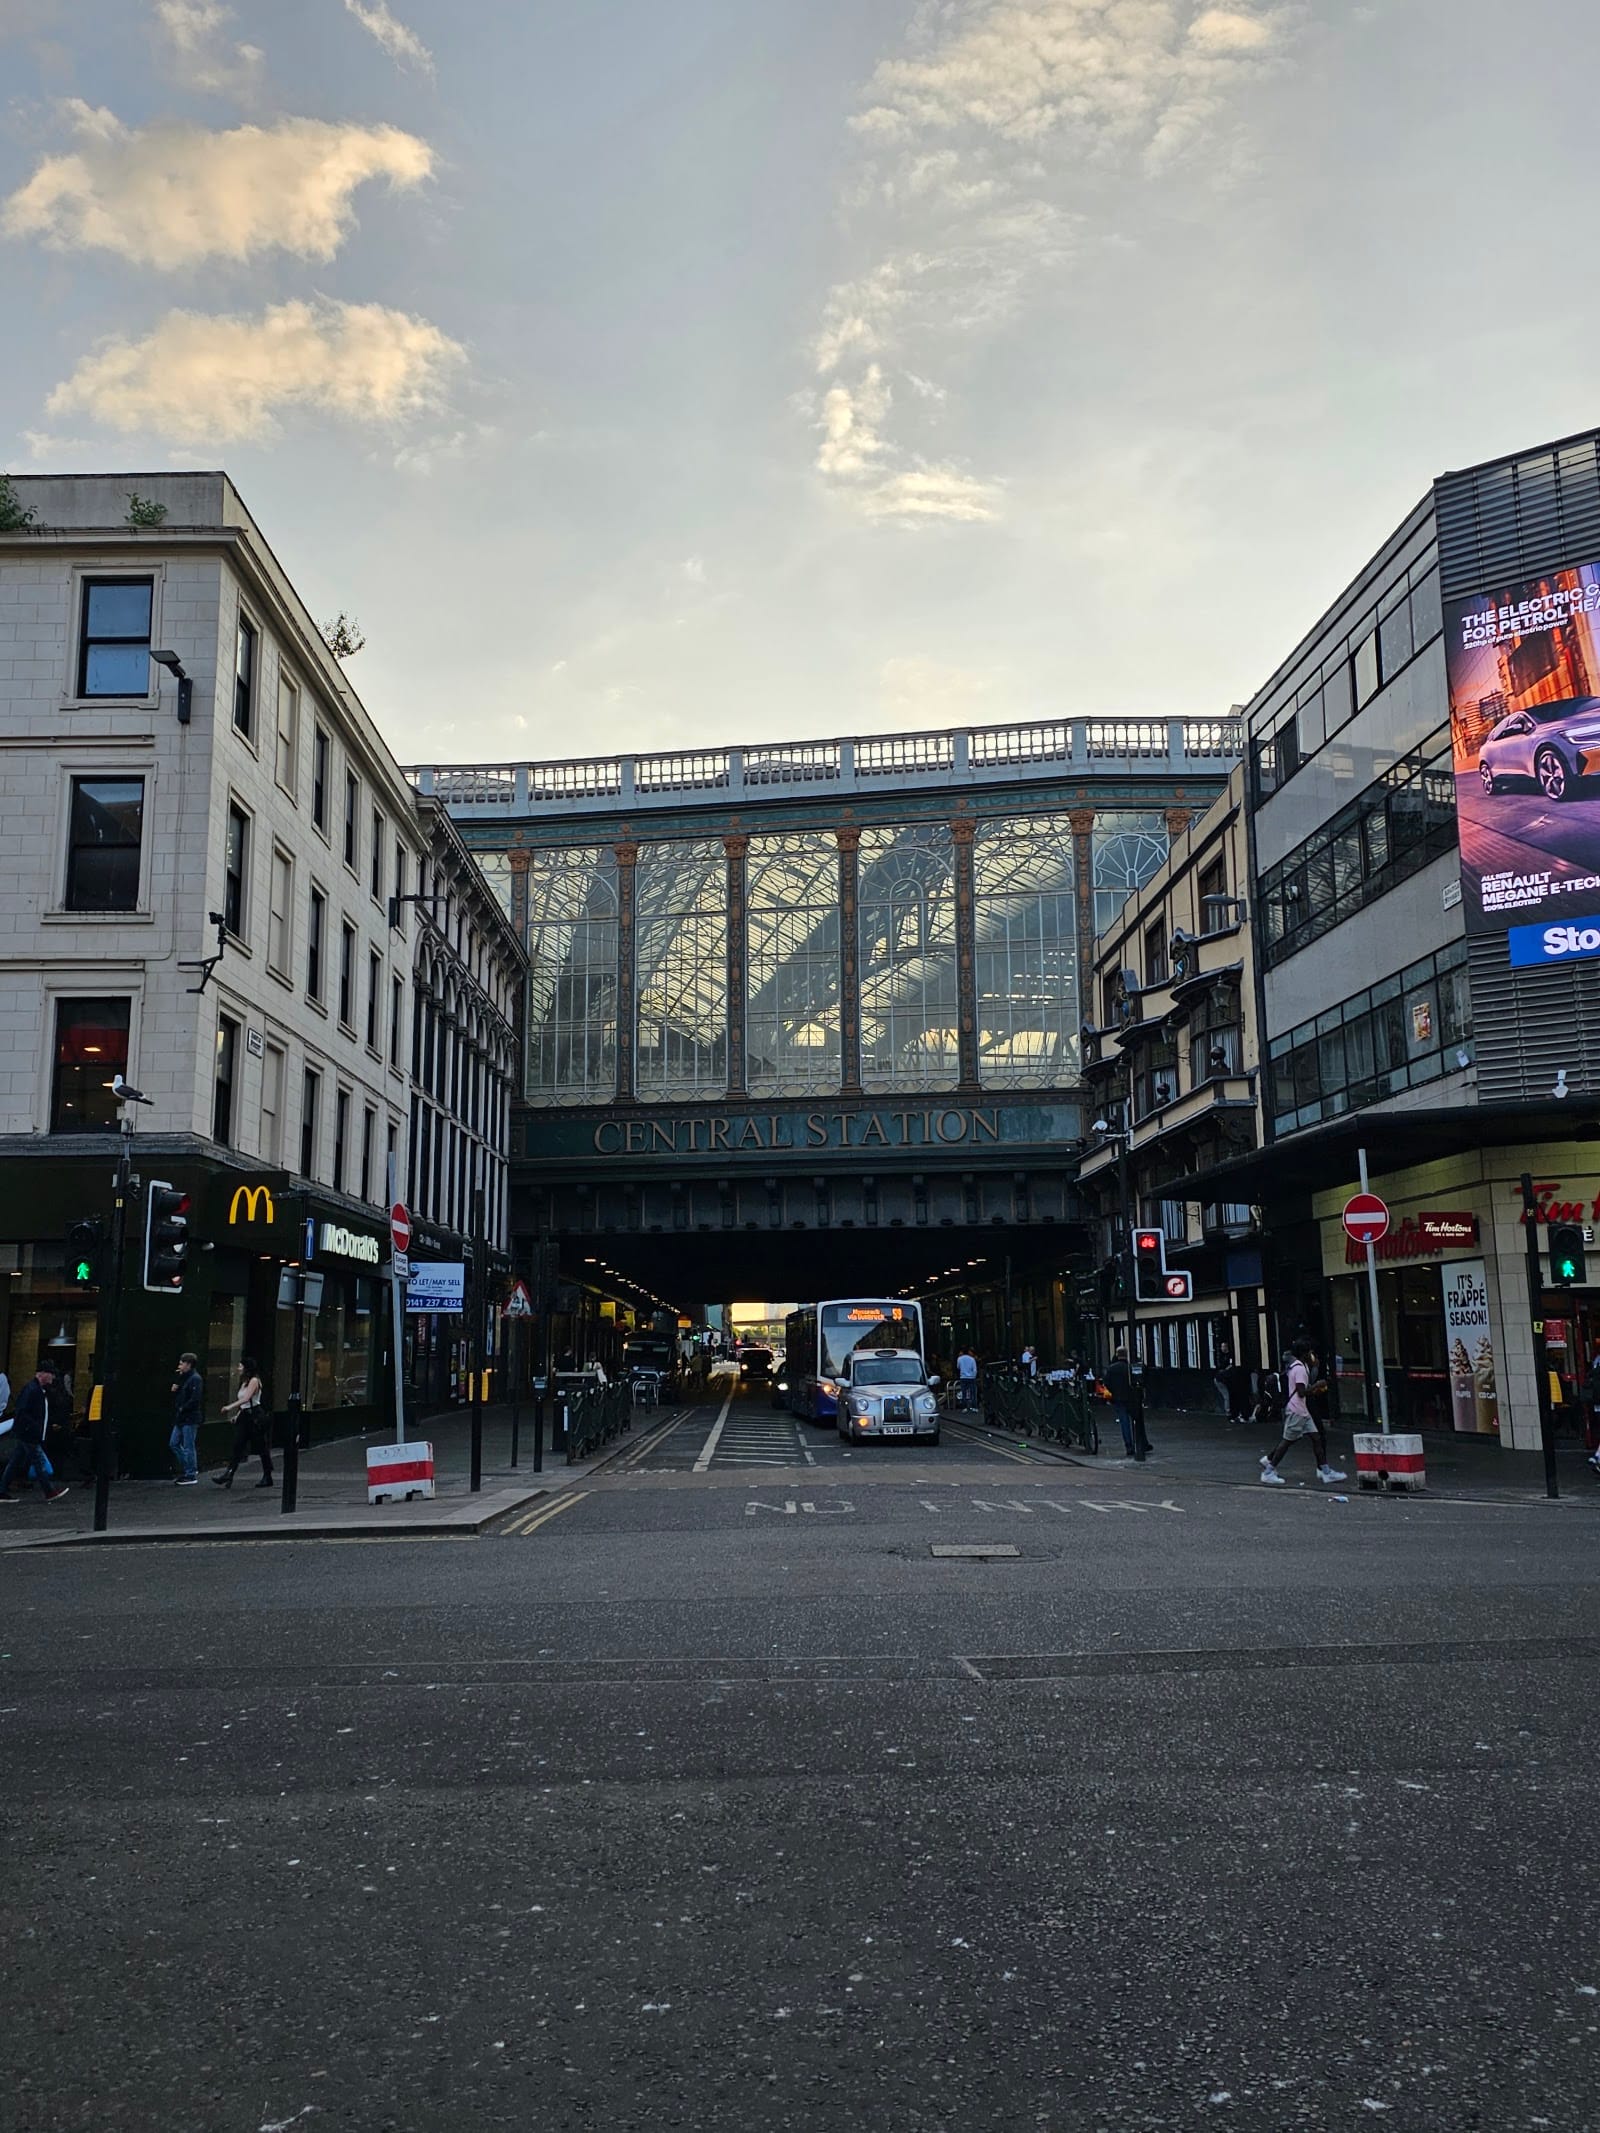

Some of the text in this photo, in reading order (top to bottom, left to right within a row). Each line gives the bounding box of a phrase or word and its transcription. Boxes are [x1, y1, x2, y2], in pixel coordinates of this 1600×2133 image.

[1462, 583, 1600, 629] THE ELECTRIC C
[1463, 623, 1497, 643] FOR
[1500, 605, 1568, 634] PETROL
[1514, 624, 1544, 637] electric
[1543, 619, 1568, 631] power
[1481, 871, 1552, 894] RENAULT
[1482, 884, 1549, 906] MEGANE
[1504, 897, 1542, 909] ELECTRIC
[1544, 926, 1600, 955] Sto
[594, 1108, 1000, 1153] CENTRAL STATION
[1424, 1221, 1472, 1233] Tim Hortons
[320, 1223, 379, 1264] McDonald's
[408, 1278, 417, 1286] TO
[1457, 1274, 1473, 1290] IT'S
[406, 1298, 462, 1307] 0141 237 4324
[1447, 1284, 1486, 1309] FRAPPÉ
[1449, 1311, 1487, 1327] SEASON!
